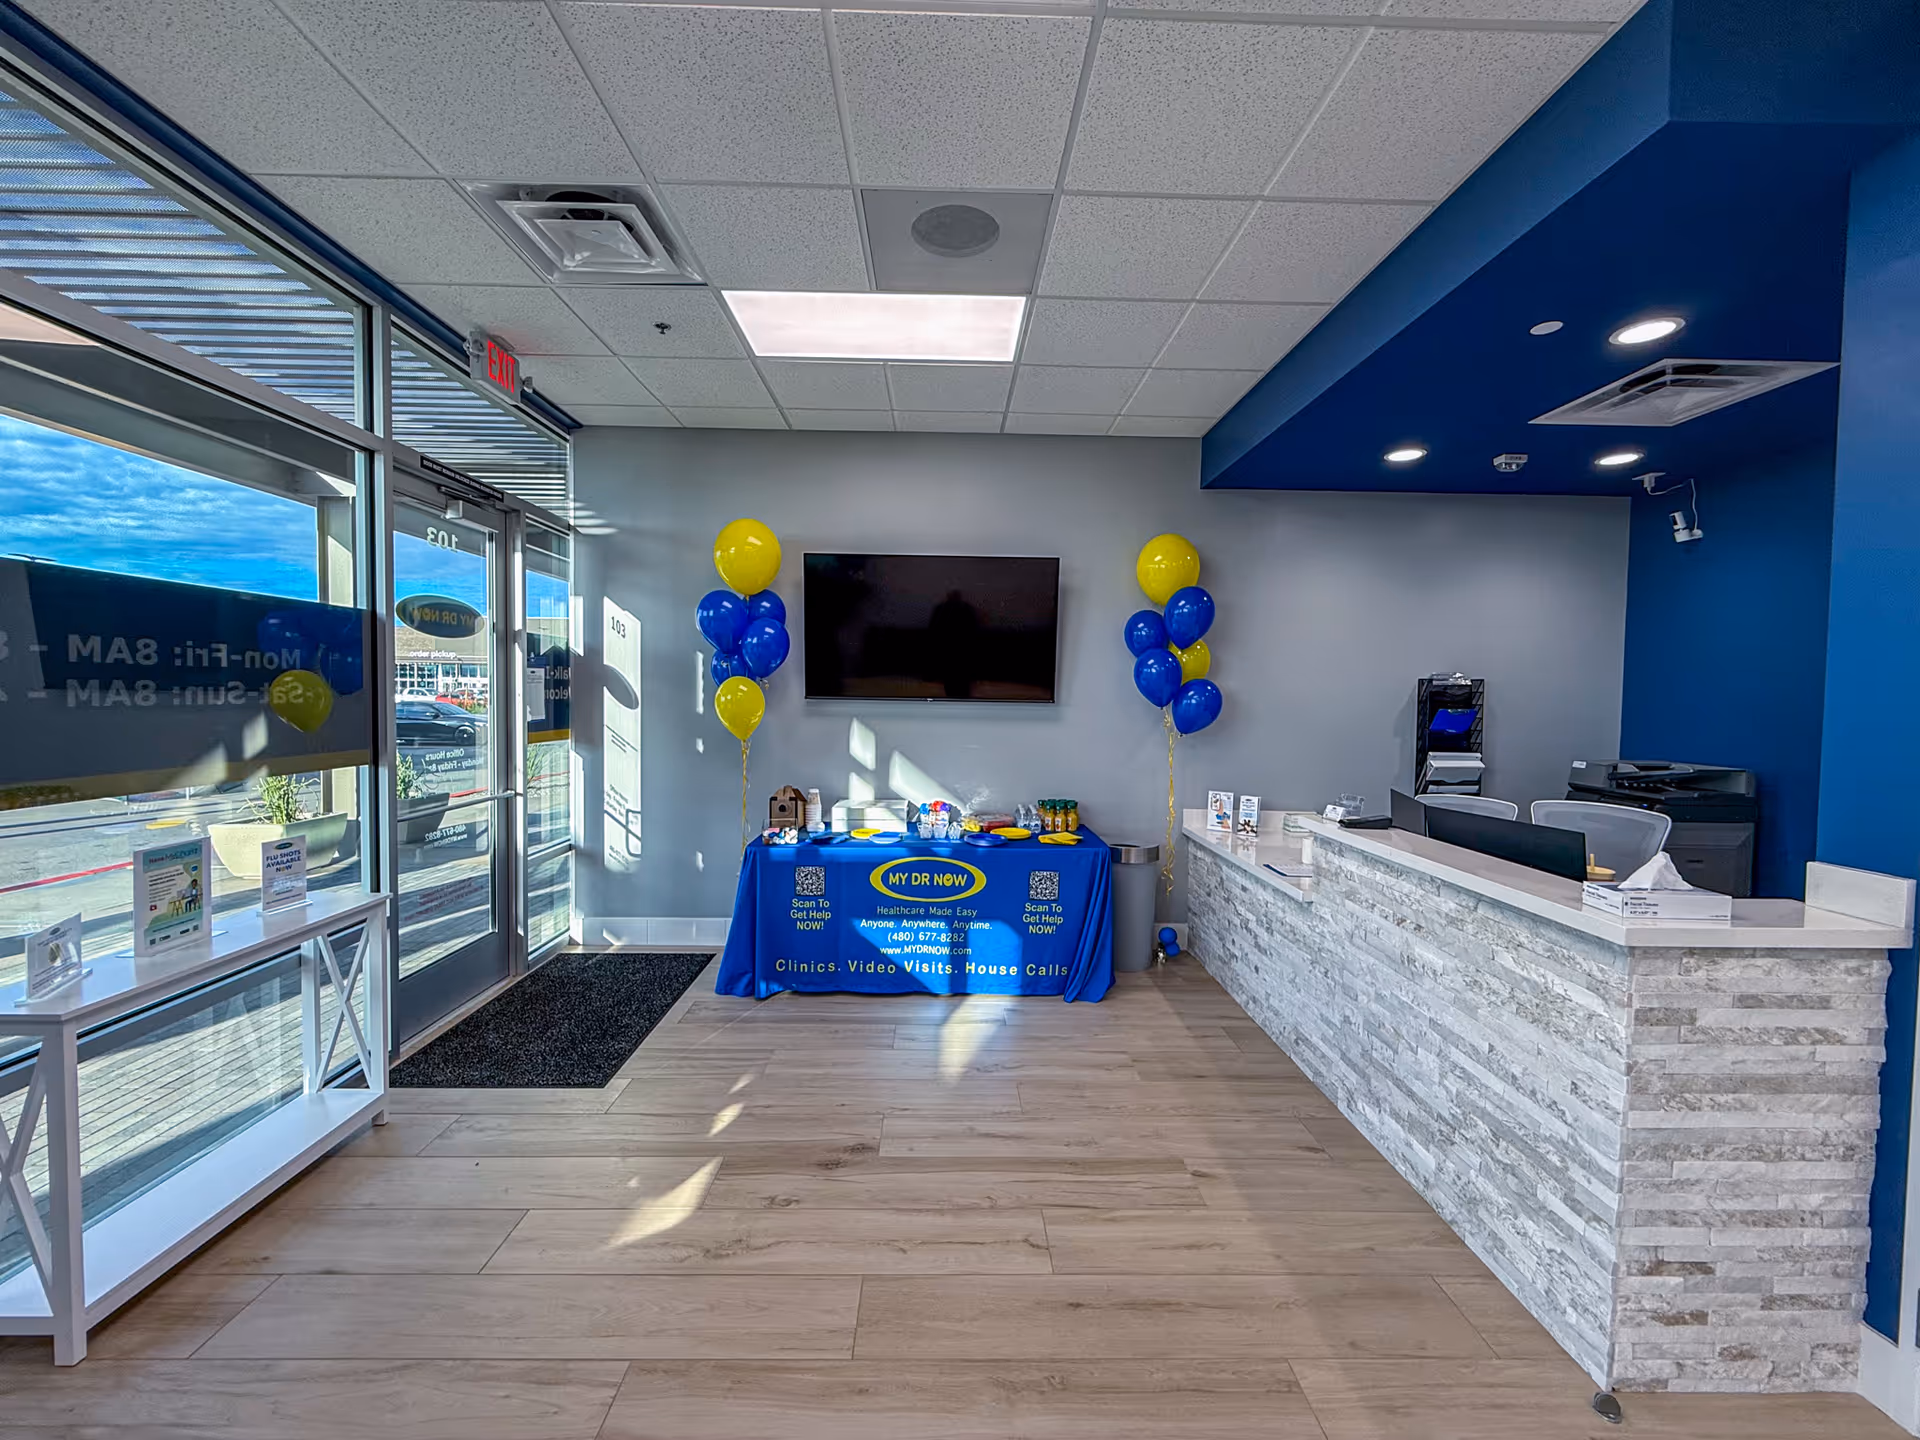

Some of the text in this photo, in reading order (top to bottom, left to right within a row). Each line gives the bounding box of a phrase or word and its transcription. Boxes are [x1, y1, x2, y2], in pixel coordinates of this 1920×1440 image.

[487, 340, 516, 394] EXIT
[611, 616, 626, 639] 103
[409, 650, 457, 660] order pickup
[265, 849, 302, 863] FLU SHOTS
[266, 856, 302, 869] AVAILABLE
[275, 864, 293, 873] NOW
[888, 873, 967, 887] MY DR NOW
[792, 898, 830, 908] Scan To
[1024, 902, 1063, 913] Scan To
[790, 909, 832, 921] Get Help
[877, 906, 978, 918] Healthcare Made Easy
[860, 919, 993, 931] Anyone. Anywhere. Anytime.
[1022, 913, 1064, 925] Get Help
[796, 921, 824, 931] NOW!
[1028, 925, 1056, 934] NOW!
[888, 932, 965, 943] (480) 677-8282
[880, 945, 972, 955] www.MYDRNOW.com
[775, 959, 1068, 976] Clinics. Video Visits. House Calls
